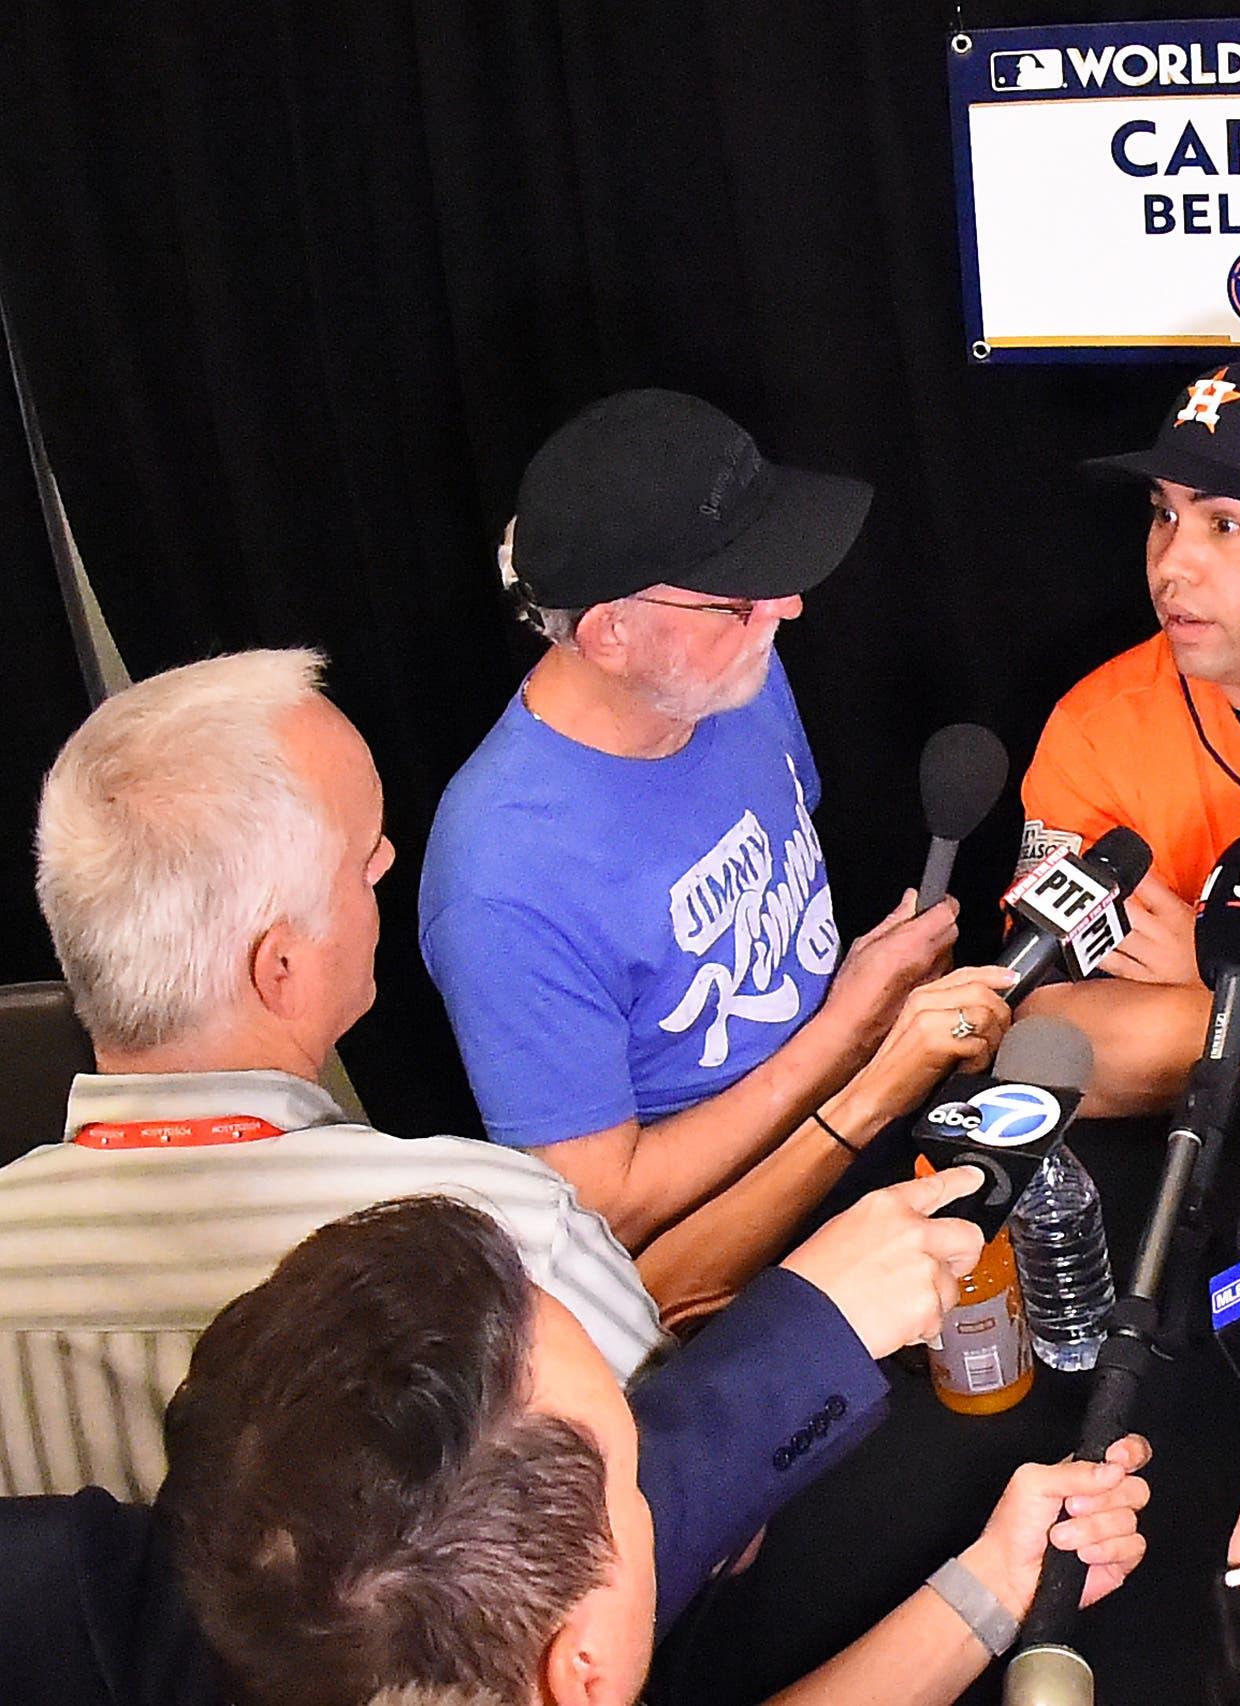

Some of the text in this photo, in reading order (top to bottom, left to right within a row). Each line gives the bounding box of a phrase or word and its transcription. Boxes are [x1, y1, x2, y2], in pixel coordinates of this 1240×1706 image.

[687, 835, 764, 938] JIMMY
[1035, 870, 1096, 917] PTF
[928, 1109, 982, 1130] abc
